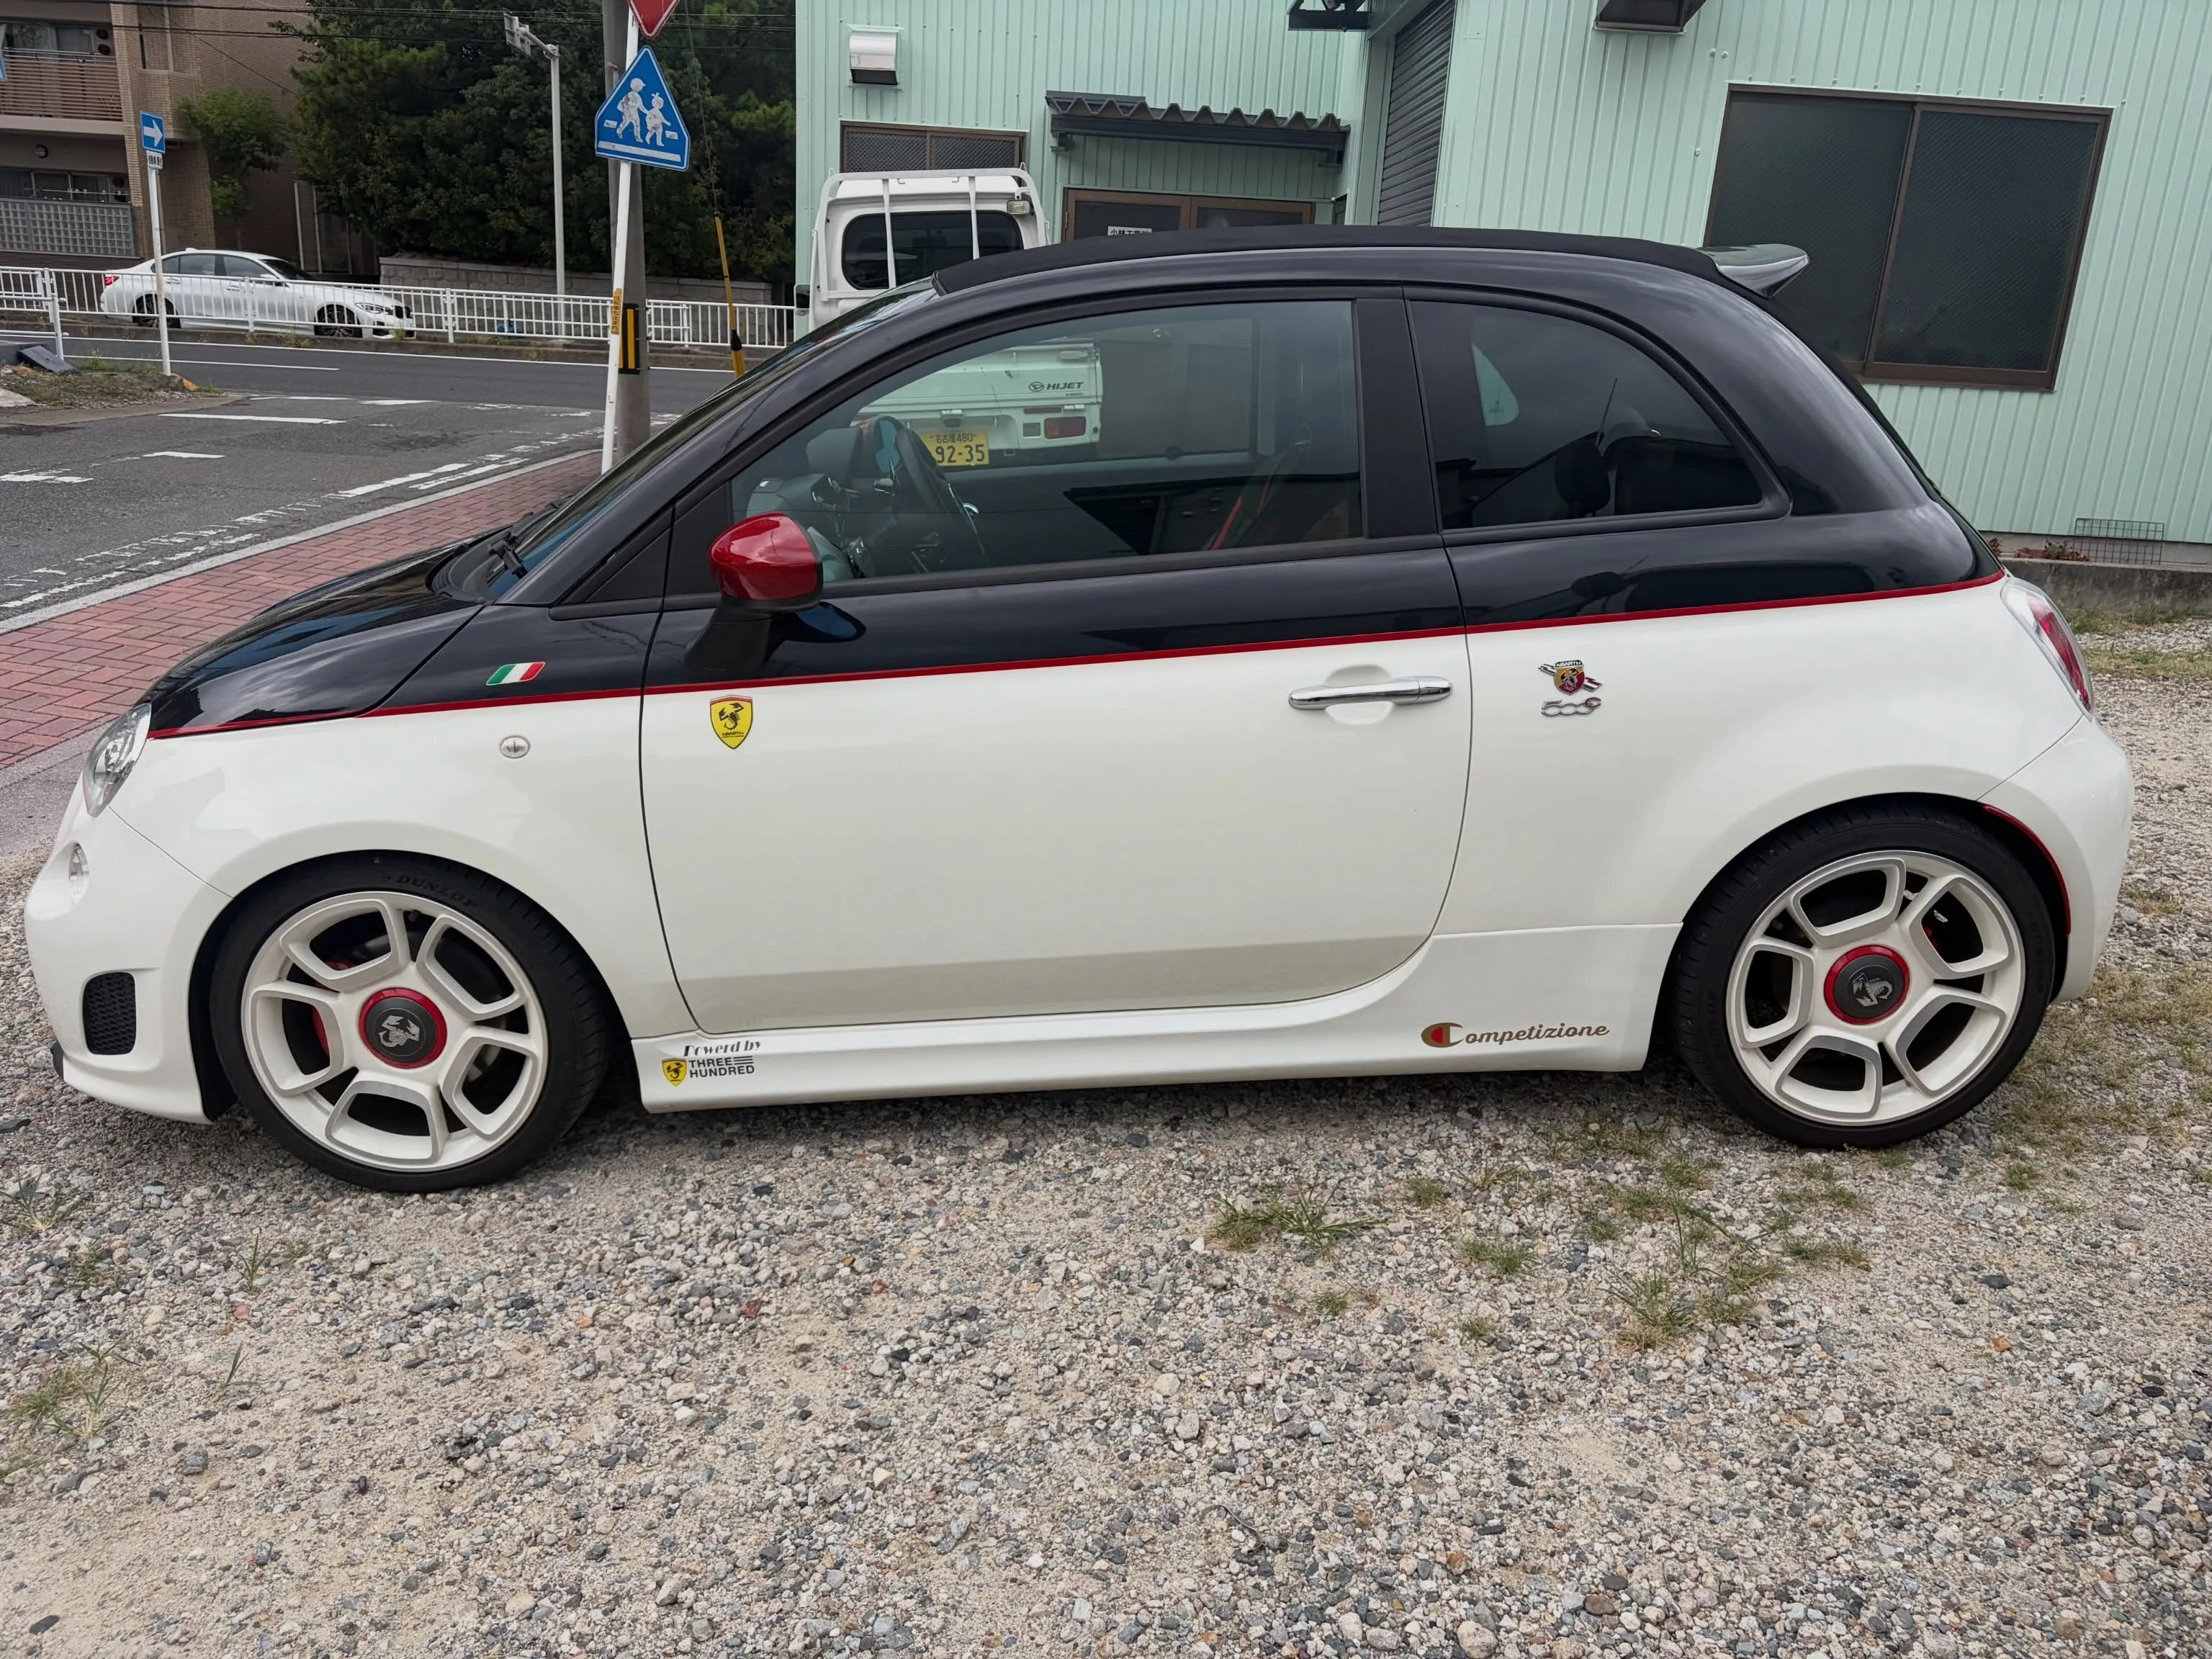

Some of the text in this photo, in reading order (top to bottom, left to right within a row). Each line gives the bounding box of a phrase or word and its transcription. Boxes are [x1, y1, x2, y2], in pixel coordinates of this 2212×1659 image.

[1046, 382, 1084, 390] HIJET
[935, 444, 985, 463] 92-35
[395, 874, 478, 907] DUNLOP
[1421, 1022, 1610, 1048] Competizione
[744, 1040, 761, 1051] by
[688, 1057, 733, 1069] THREE
[690, 1065, 755, 1078] HUNDRED
